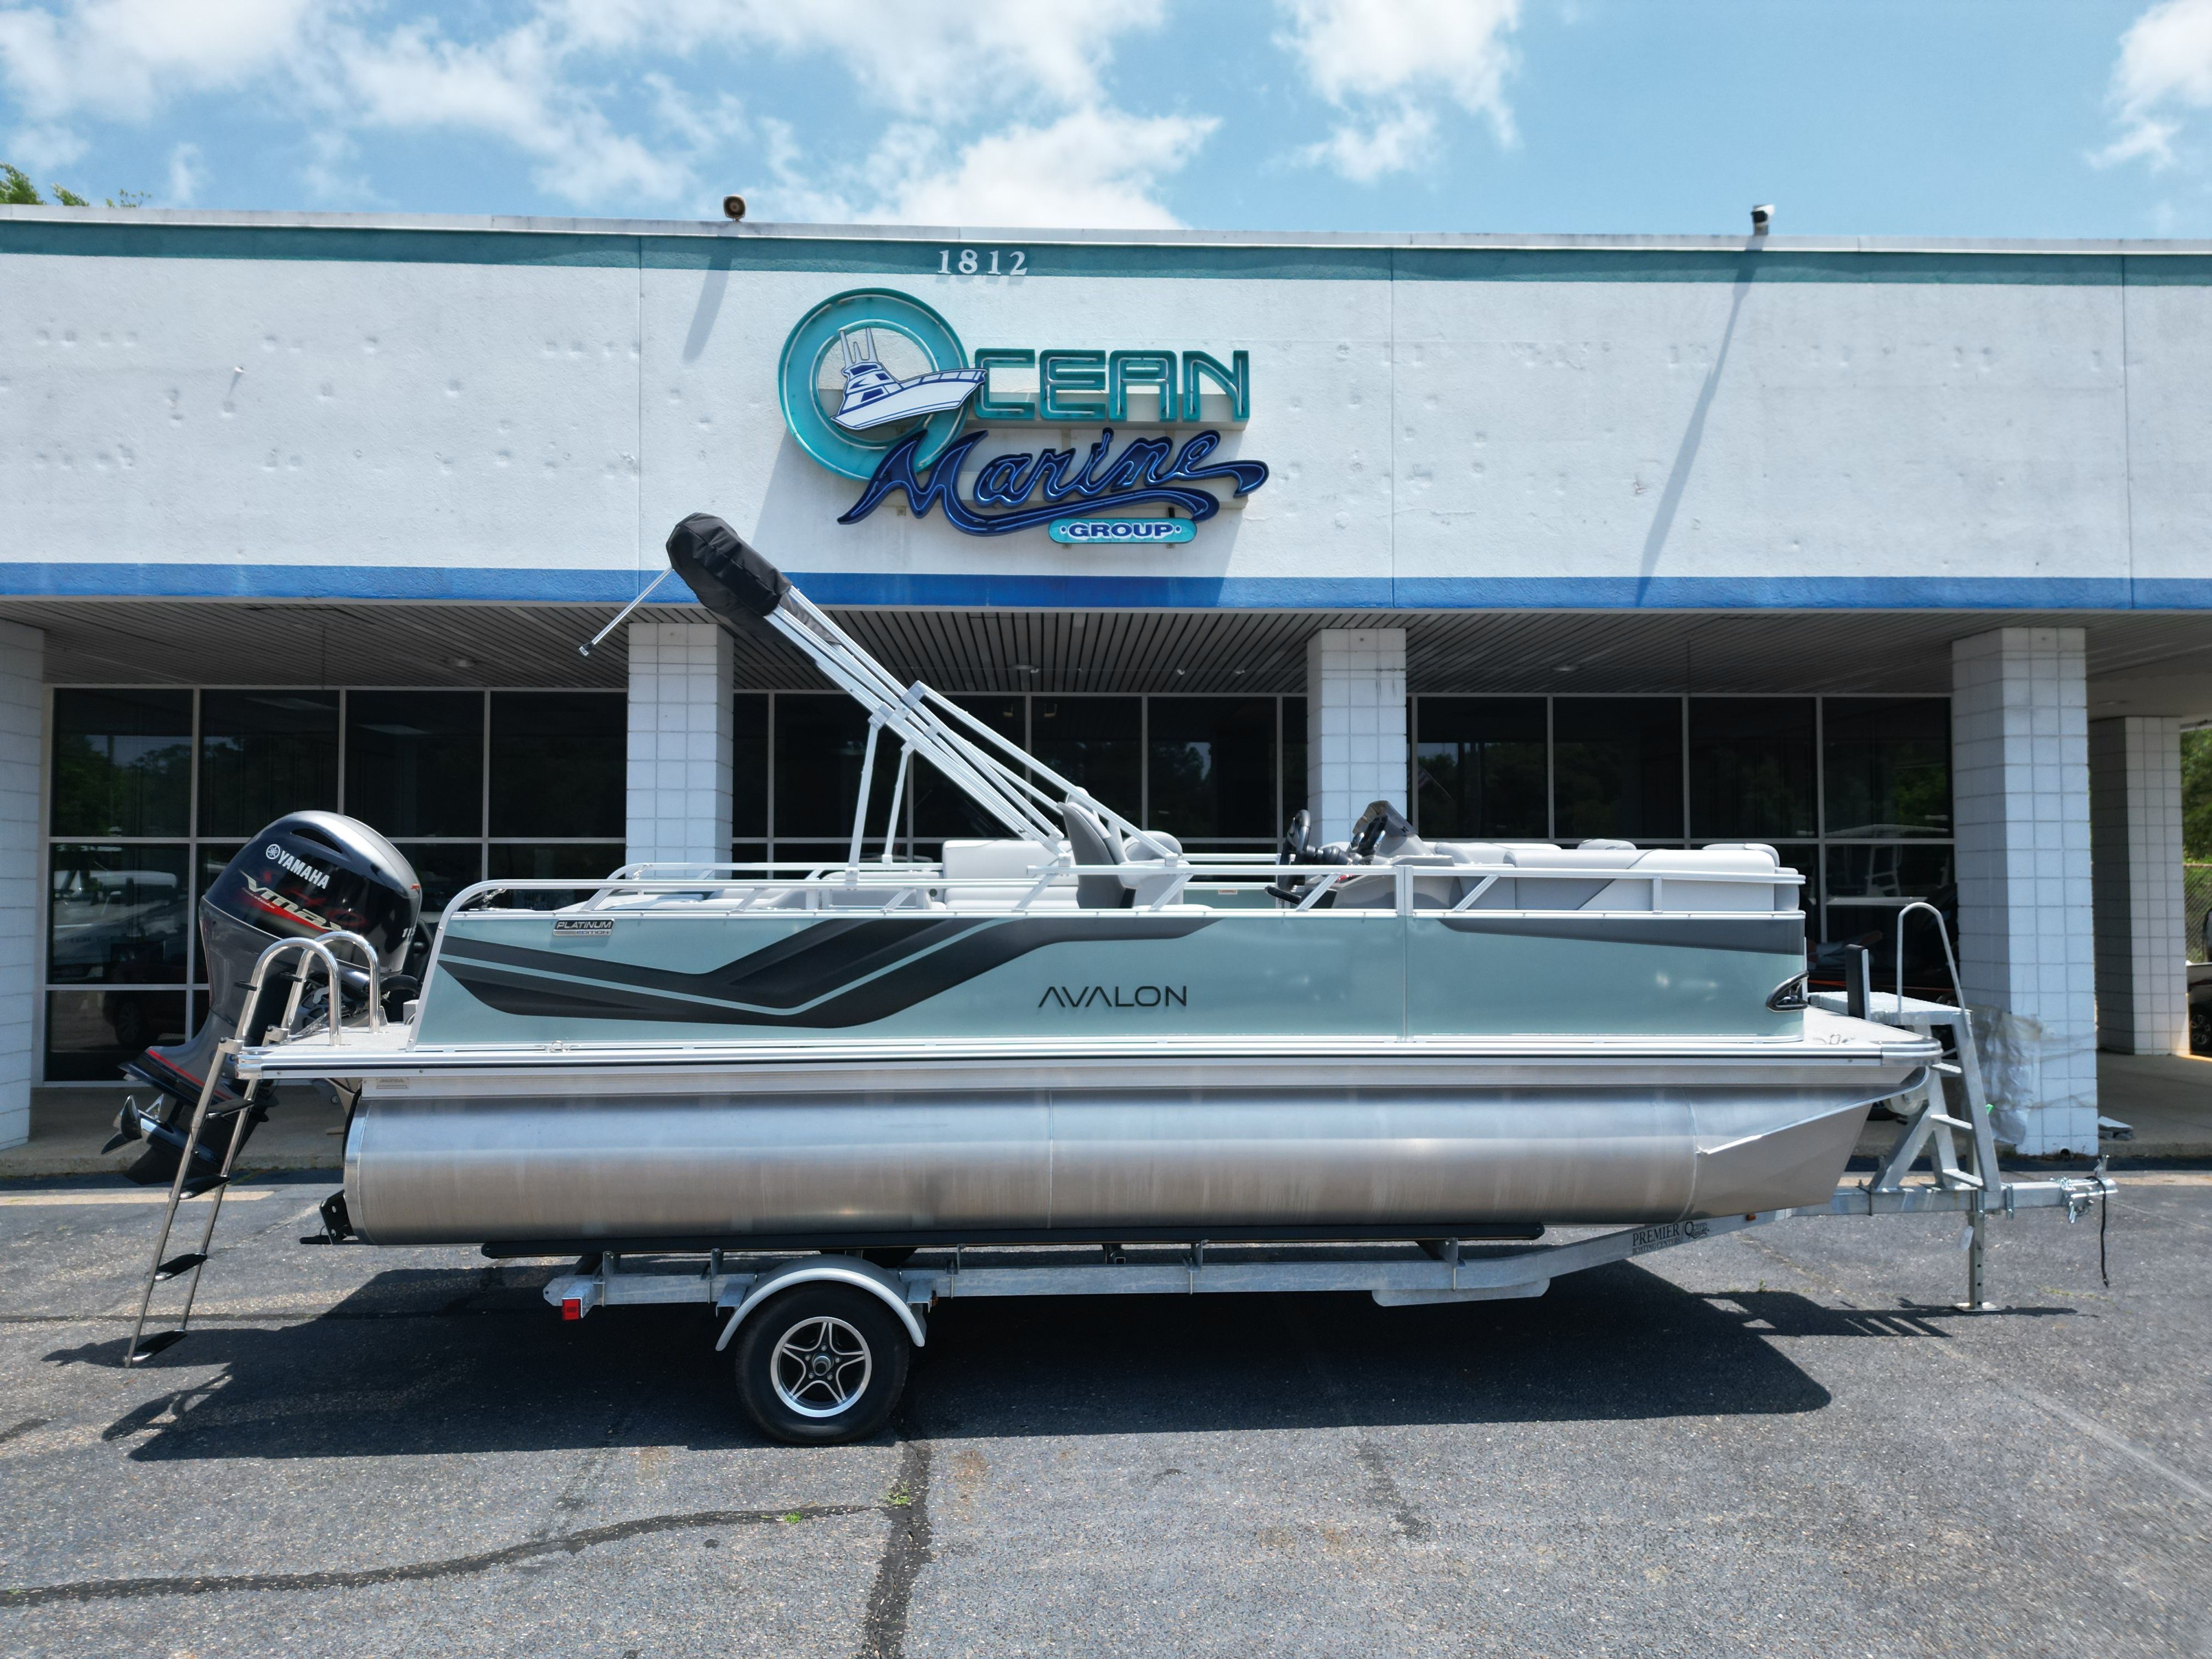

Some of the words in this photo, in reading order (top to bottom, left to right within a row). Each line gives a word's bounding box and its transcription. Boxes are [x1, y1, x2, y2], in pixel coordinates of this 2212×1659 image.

[937, 249, 1028, 275] 1812
[837, 427, 1269, 537] Marine
[1068, 523, 1173, 538] GROUP
[278, 850, 330, 889] YAMAHA
[1038, 985, 1187, 1008] AVALON
[1632, 1223, 1680, 1246] PREMIER
